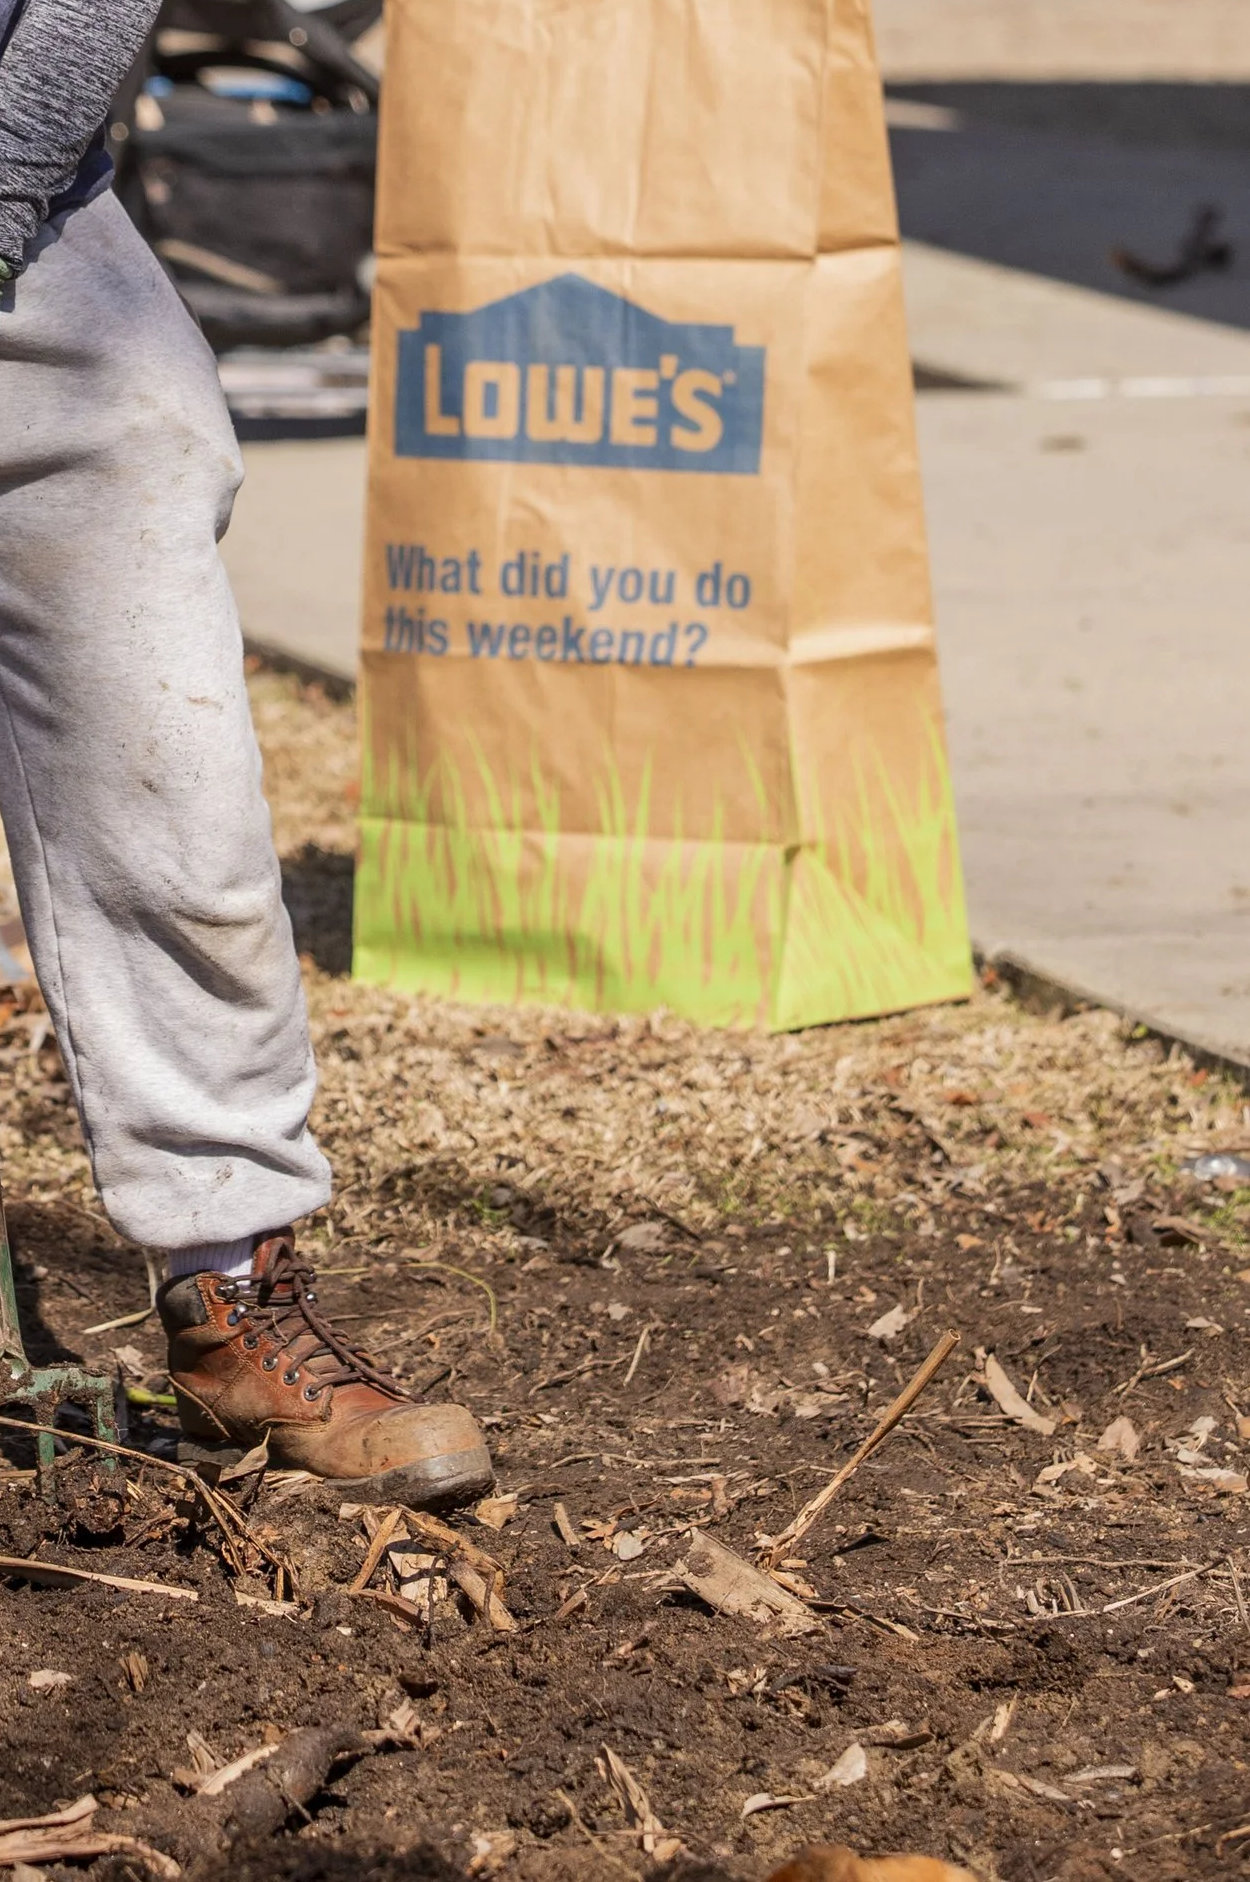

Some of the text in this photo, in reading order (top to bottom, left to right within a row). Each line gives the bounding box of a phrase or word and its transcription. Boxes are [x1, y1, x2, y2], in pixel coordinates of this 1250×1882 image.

[424, 343, 724, 453] LOWE'S
[385, 544, 752, 611] What did you do
[383, 606, 709, 668] this weekend?
